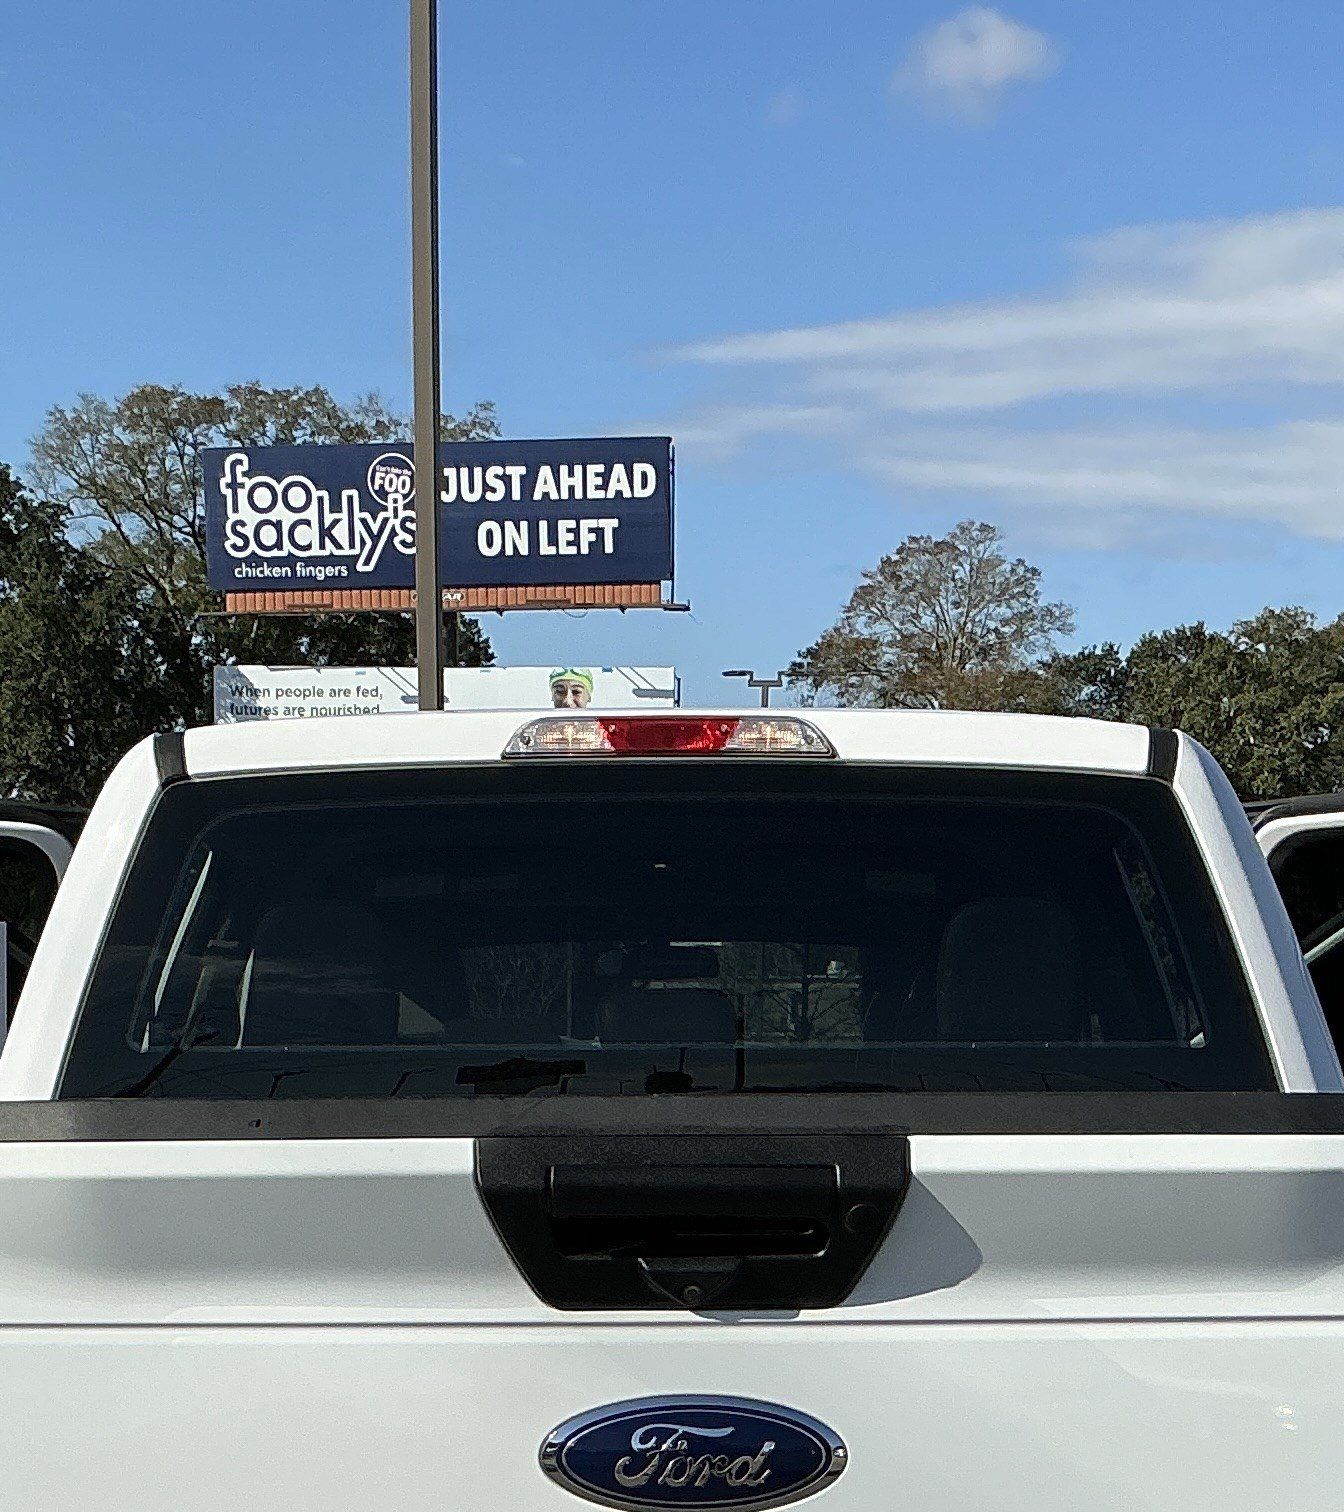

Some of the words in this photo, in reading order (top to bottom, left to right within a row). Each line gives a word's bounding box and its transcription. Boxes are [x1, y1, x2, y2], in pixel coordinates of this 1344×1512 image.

[221, 453, 316, 516] foo
[373, 471, 411, 495] FOO
[440, 465, 527, 503] JUST
[532, 462, 657, 501] AHEAD
[477, 519, 529, 557] ON
[538, 517, 619, 556] LEFT
[234, 562, 292, 578] chicken
[295, 561, 349, 581] fingers
[229, 685, 271, 698] When
[275, 685, 324, 703] people
[328, 688, 352, 698] are
[356, 685, 384, 701] fed,
[229, 703, 279, 717] futures
[283, 705, 305, 717] are
[614, 1423, 775, 1487] Ford
